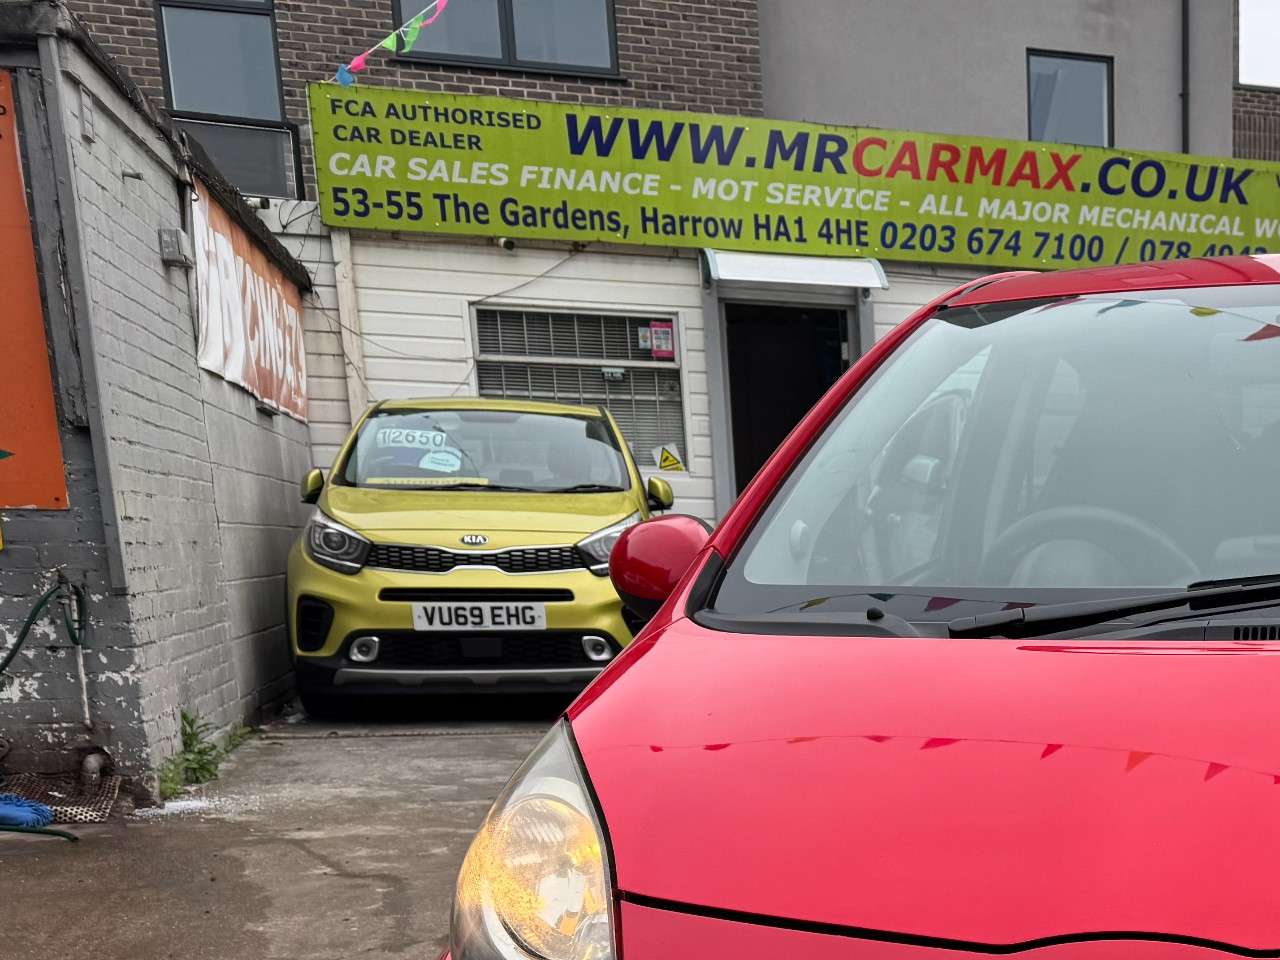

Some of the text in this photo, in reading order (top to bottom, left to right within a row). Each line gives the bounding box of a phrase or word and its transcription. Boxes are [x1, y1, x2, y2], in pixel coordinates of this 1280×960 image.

[329, 98, 542, 130] FCA AUTHORISED
[332, 124, 483, 151] CAR DEALER
[565, 113, 1254, 205] WWW.MRCARMAX.CO.UK
[328, 152, 396, 179] CAR
[407, 158, 509, 186] SALES
[519, 165, 661, 196] FINANCE
[691, 176, 759, 202] MOT
[766, 182, 892, 212] SERVICE
[918, 193, 969, 217] ALL
[978, 198, 1070, 224] MAJOR
[1078, 205, 1245, 237] MECHANICAL
[331, 187, 424, 221] 53-55
[433, 193, 490, 225] The
[500, 197, 631, 239] Gardens,
[640, 206, 743, 240] Harrow
[753, 213, 808, 243] HA1
[817, 218, 869, 247] 4HE
[879, 220, 957, 253] 0203
[967, 226, 1021, 257] 674
[1032, 231, 1104, 263] 7100
[463, 535, 484, 544] KIA
[422, 606, 536, 626] VU69 EHG
